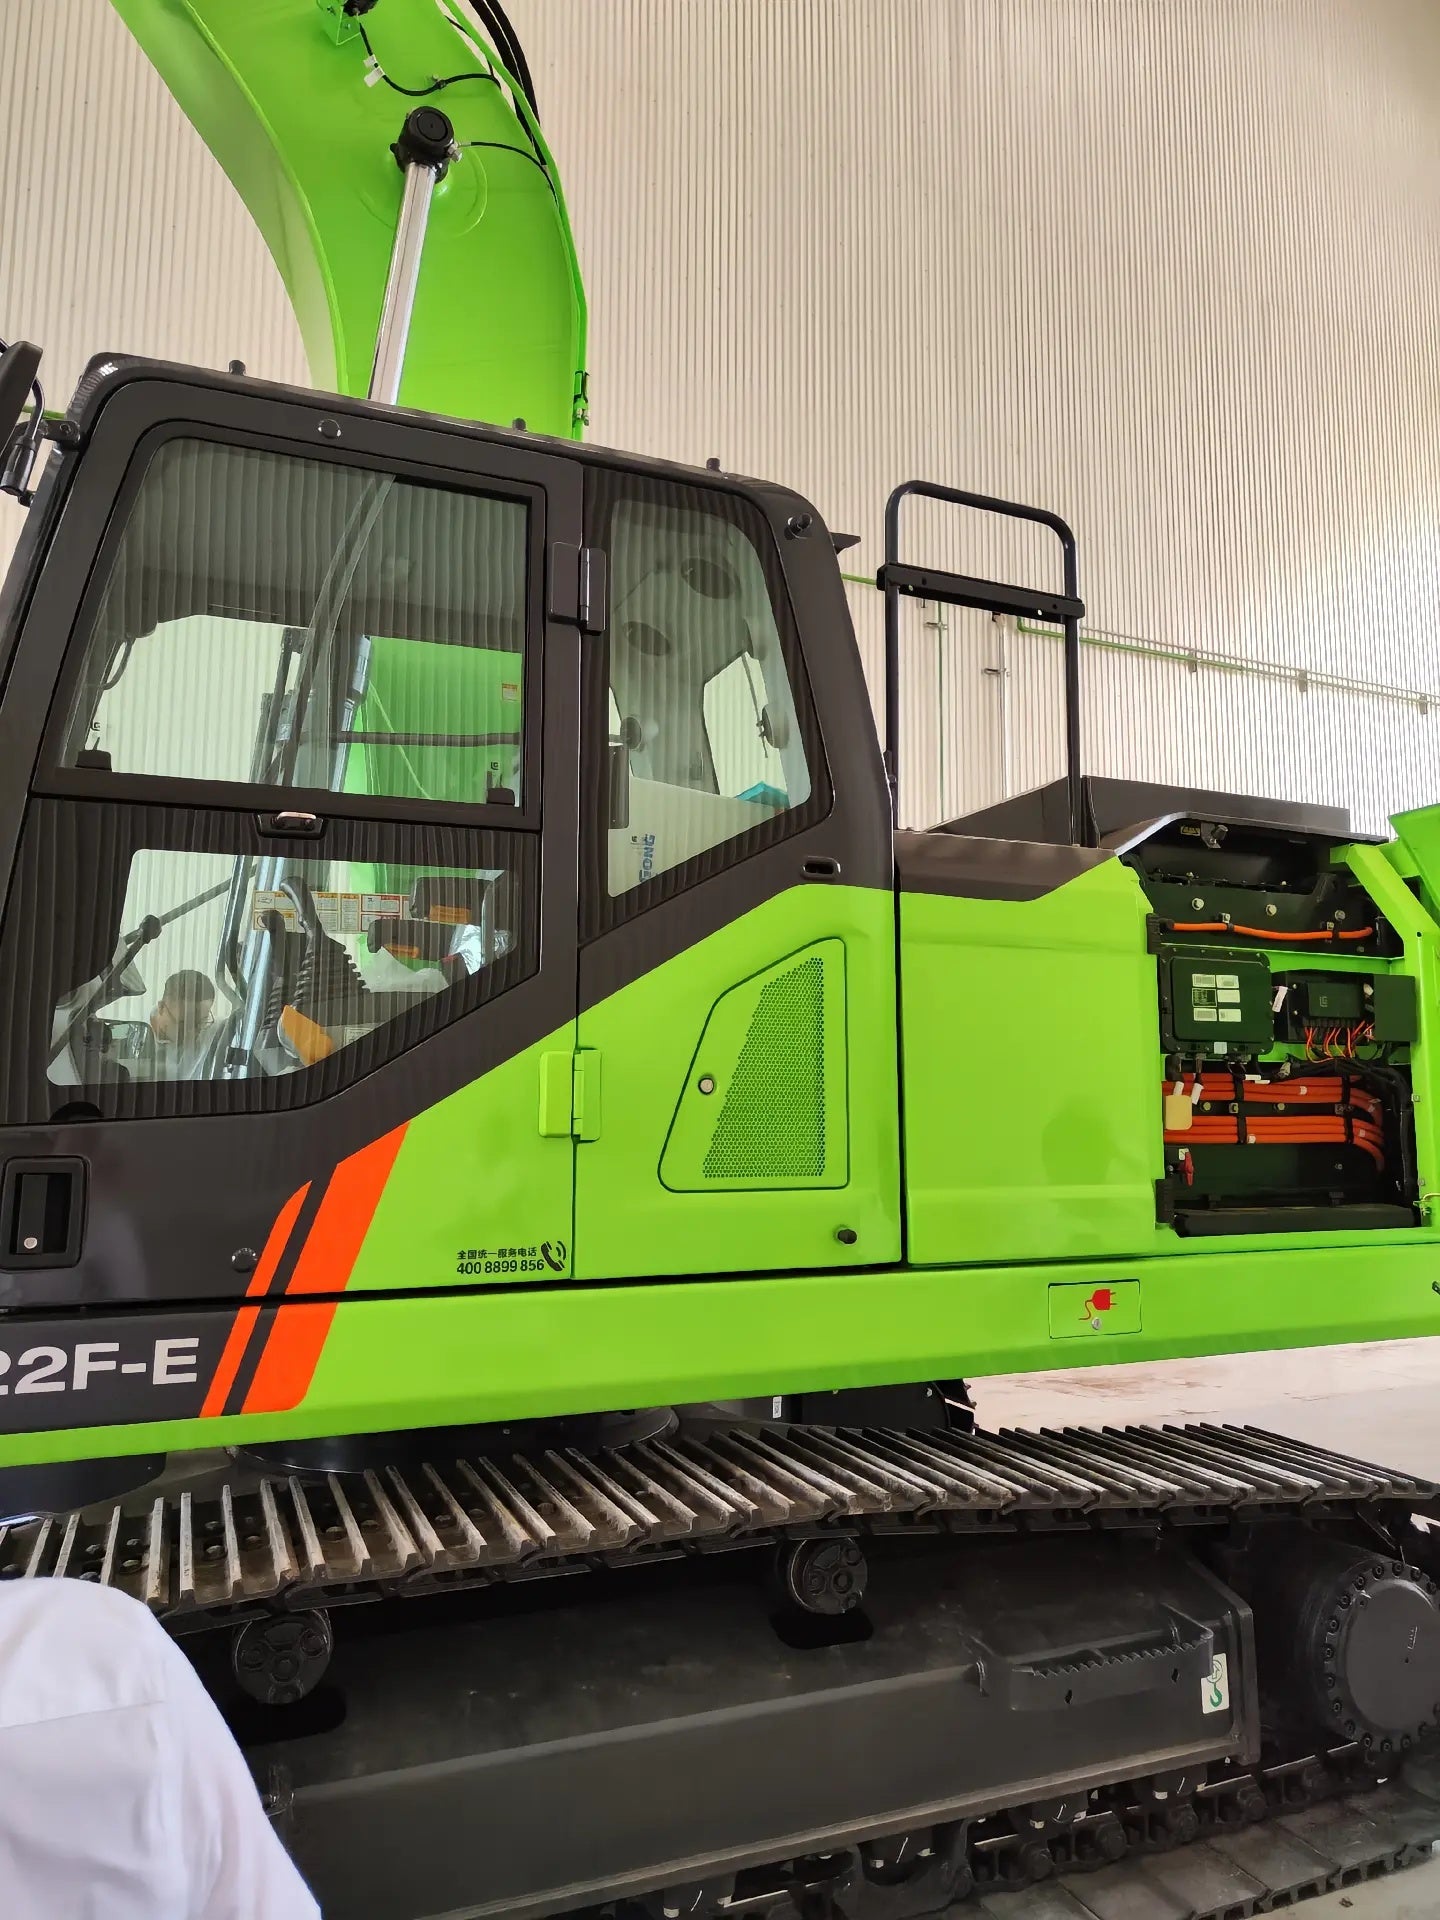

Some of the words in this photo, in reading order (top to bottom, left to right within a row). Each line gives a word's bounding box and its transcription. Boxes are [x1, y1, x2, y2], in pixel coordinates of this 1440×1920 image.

[457, 1247, 537, 1260] 全国统一服务电话
[457, 1262, 481, 1274] 400
[484, 1260, 517, 1273] 8899
[520, 1259, 544, 1271] 856
[0, 1338, 199, 1396] 2F-E
